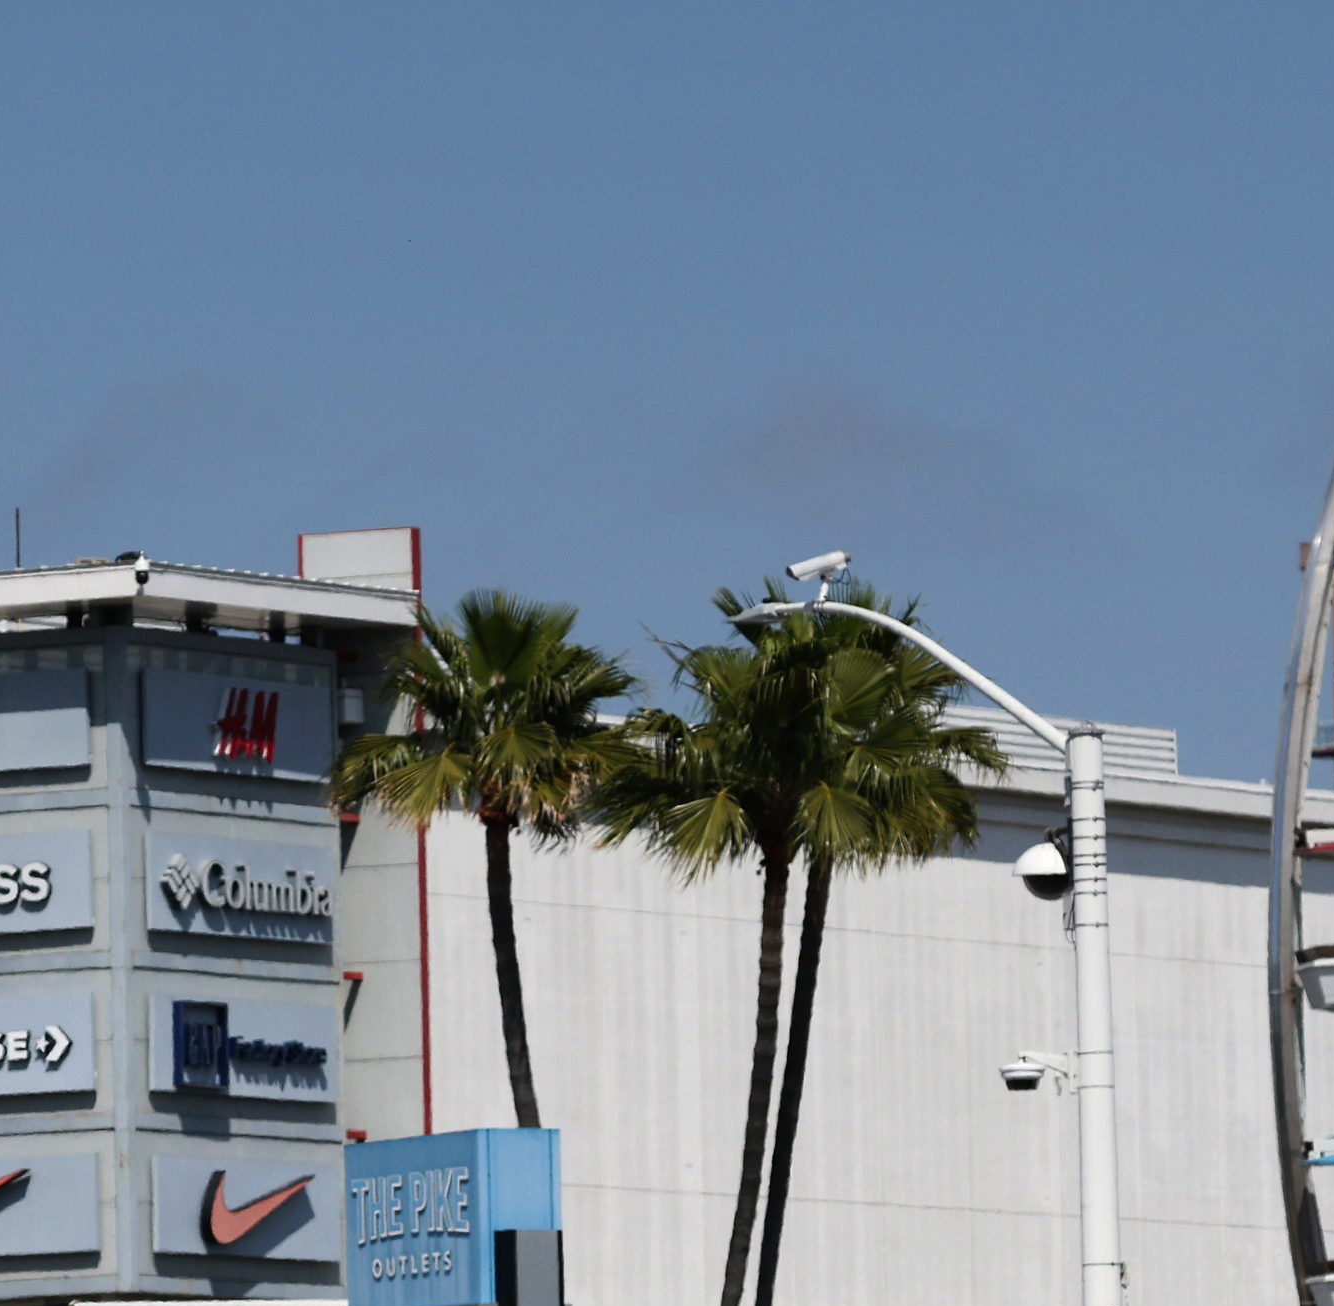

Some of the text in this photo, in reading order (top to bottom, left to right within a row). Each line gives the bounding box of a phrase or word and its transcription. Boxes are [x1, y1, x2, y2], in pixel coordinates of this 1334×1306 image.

[215, 686, 279, 764] H&M
[198, 858, 333, 916] Columbia
[351, 1166, 470, 1246] THE PIKE
[371, 1249, 453, 1280] OUTLETS
